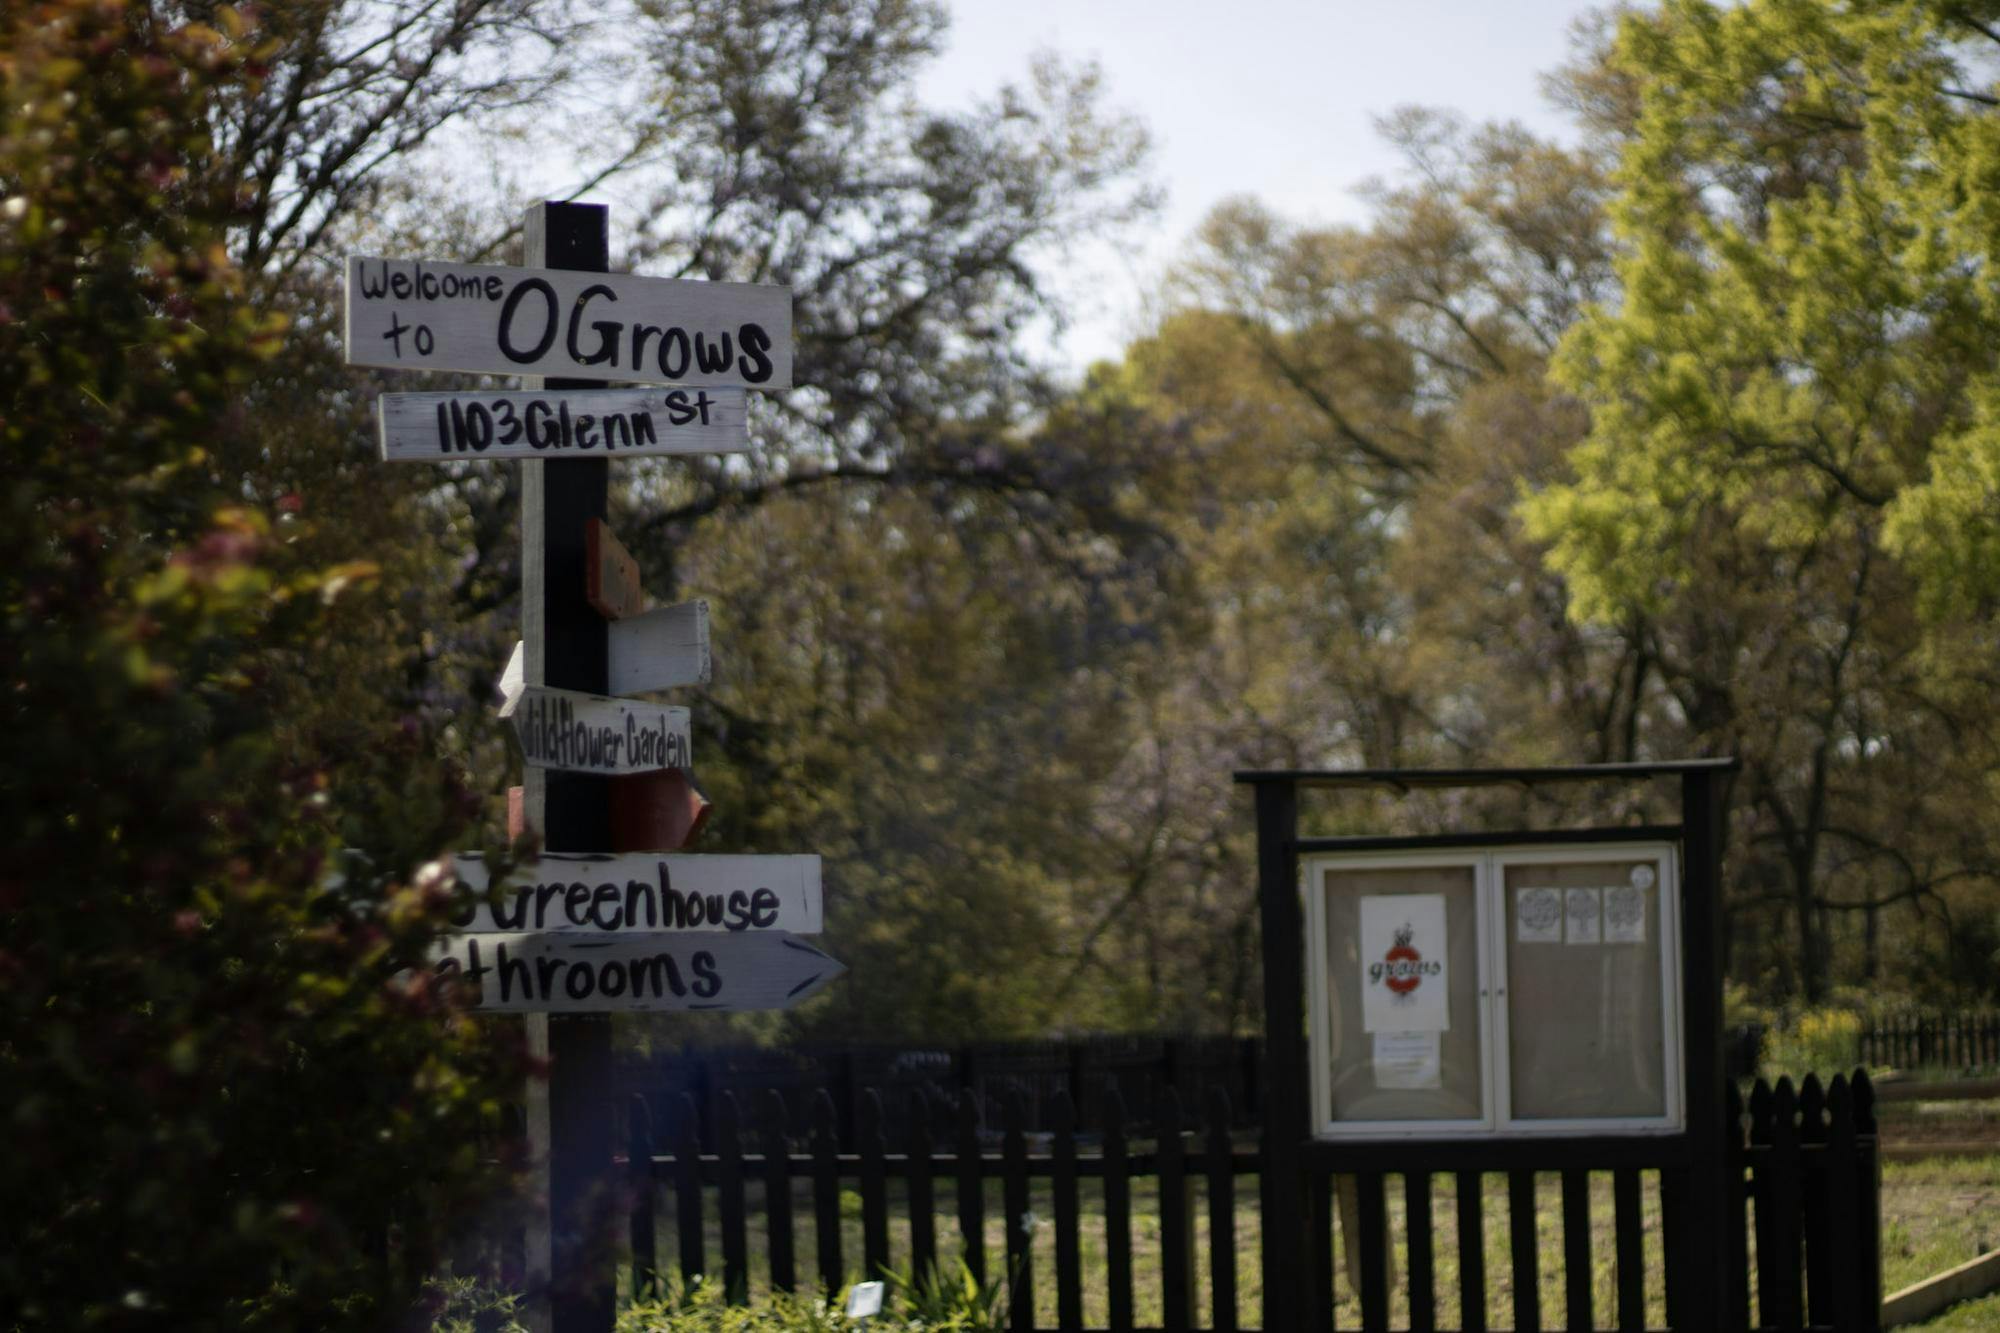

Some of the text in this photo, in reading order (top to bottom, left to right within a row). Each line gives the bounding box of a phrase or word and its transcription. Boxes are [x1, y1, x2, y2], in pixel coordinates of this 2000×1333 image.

[359, 261, 503, 301] Welcome
[383, 311, 434, 357] to
[498, 277, 774, 384] OGrows
[437, 391, 716, 453] 1103 Glenn St
[626, 712, 689, 769] Garden
[434, 938, 722, 1006] athrooms
